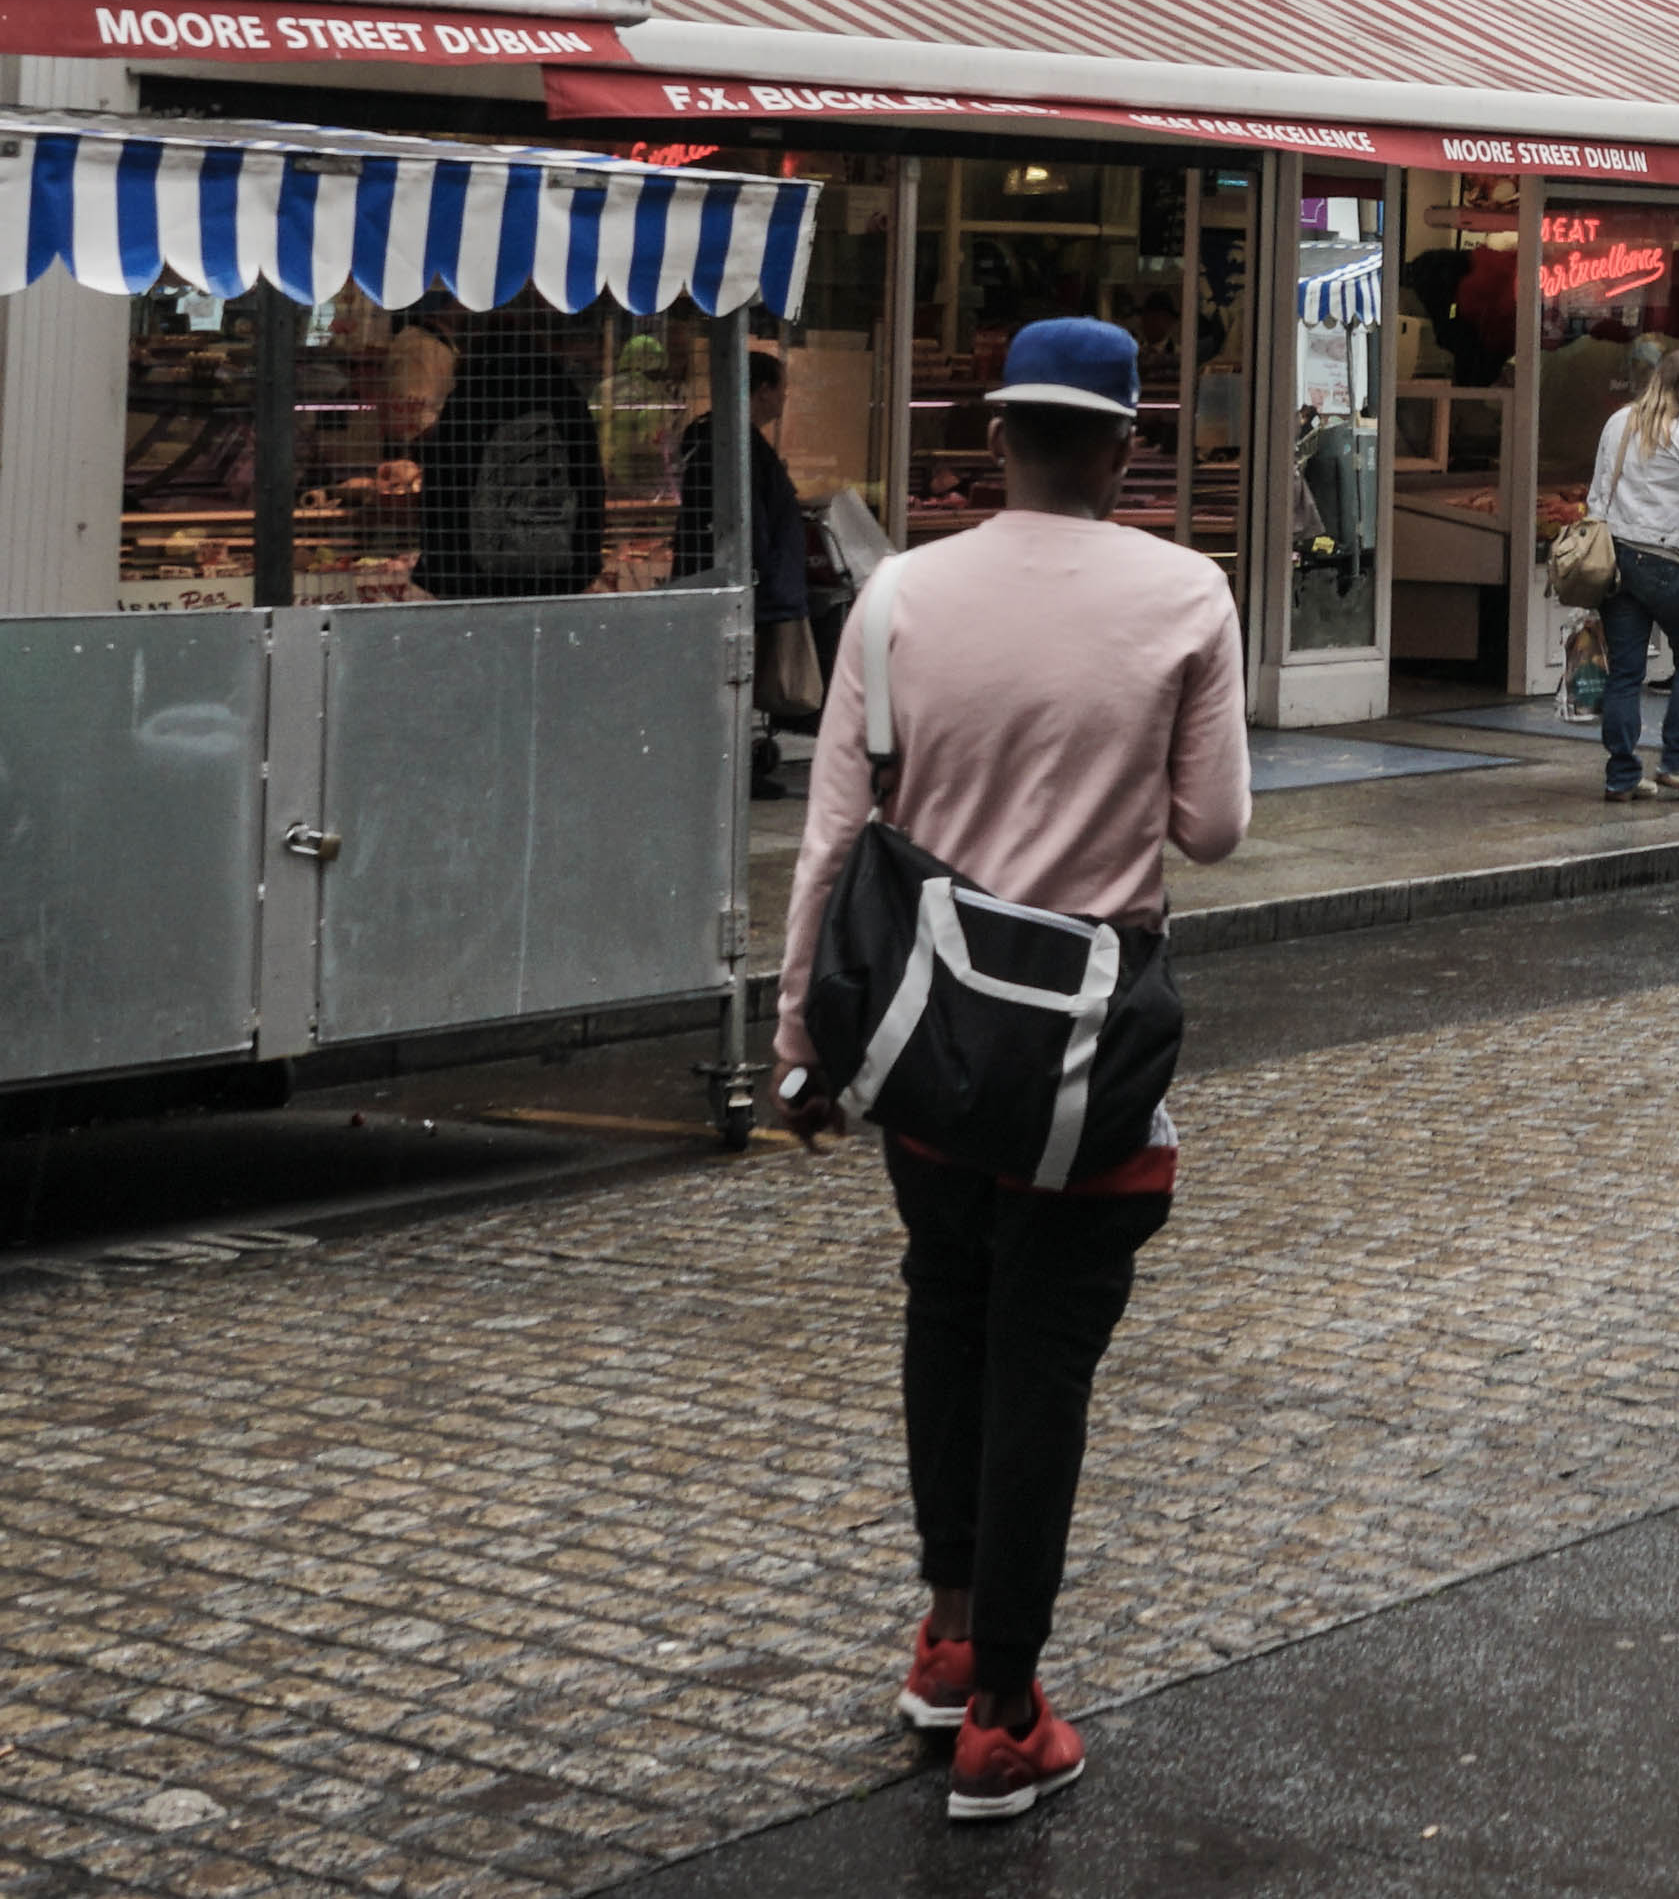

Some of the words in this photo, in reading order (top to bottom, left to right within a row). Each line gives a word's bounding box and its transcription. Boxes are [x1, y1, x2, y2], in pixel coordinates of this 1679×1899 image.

[97, 7, 272, 52] MOORE
[276, 16, 429, 57] STREET
[440, 25, 593, 58] DUBLIN
[661, 85, 750, 112] F.X.
[749, 86, 966, 113] BUCKLEY
[1200, 118, 1248, 138] PAR
[1247, 122, 1377, 153] EXCELLENCE
[1442, 138, 1516, 164] MOORE
[1520, 142, 1582, 168] STREET
[1585, 147, 1649, 173] DUBLIN
